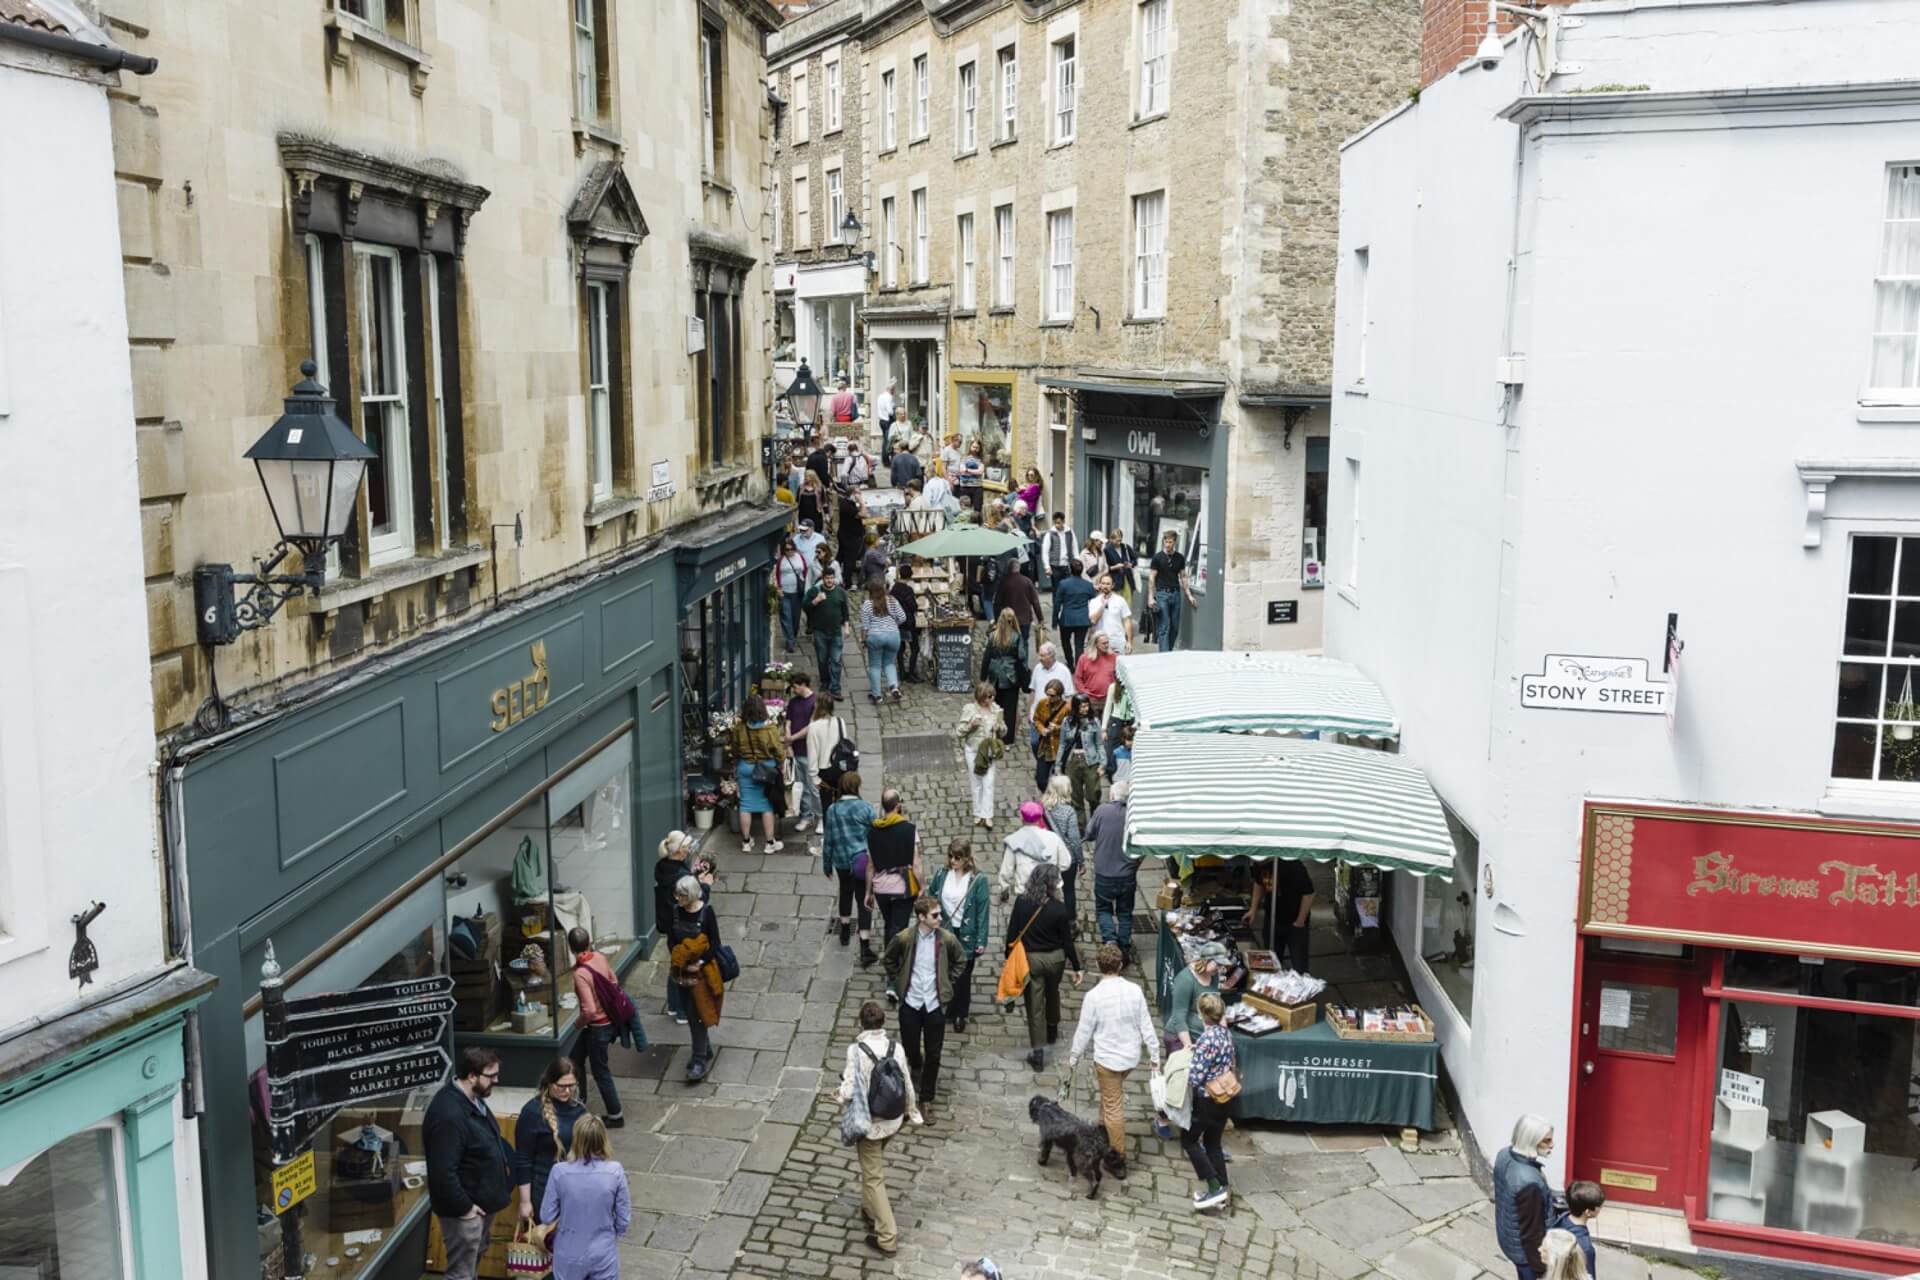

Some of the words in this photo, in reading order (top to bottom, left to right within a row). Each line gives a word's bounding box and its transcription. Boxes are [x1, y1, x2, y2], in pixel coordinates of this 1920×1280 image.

[763, 447, 770, 457] 5
[1128, 430, 1160, 456] OWL
[204, 605, 216, 624] 6
[490, 660, 549, 732] SEED
[1526, 685, 1587, 700] STONY
[1598, 688, 1664, 705] STREET
[1687, 851, 1819, 898] Sirens
[394, 981, 441, 996] TOILETS
[397, 1002, 447, 1016] MUSEUM
[302, 1033, 349, 1050] TOURIST
[356, 1016, 433, 1038] INFORMATION
[327, 1041, 363, 1059] BLACK
[370, 1037, 400, 1050] SWAN
[407, 1028, 433, 1041] ARTS
[350, 1065, 391, 1080] CHEAP
[396, 1056, 440, 1071] STREET
[1303, 1056, 1372, 1069] SOMERSET
[349, 1079, 399, 1095] MARKET
[404, 1070, 441, 1085] PLACE
[1311, 1070, 1370, 1079] CHARCUTERIE
